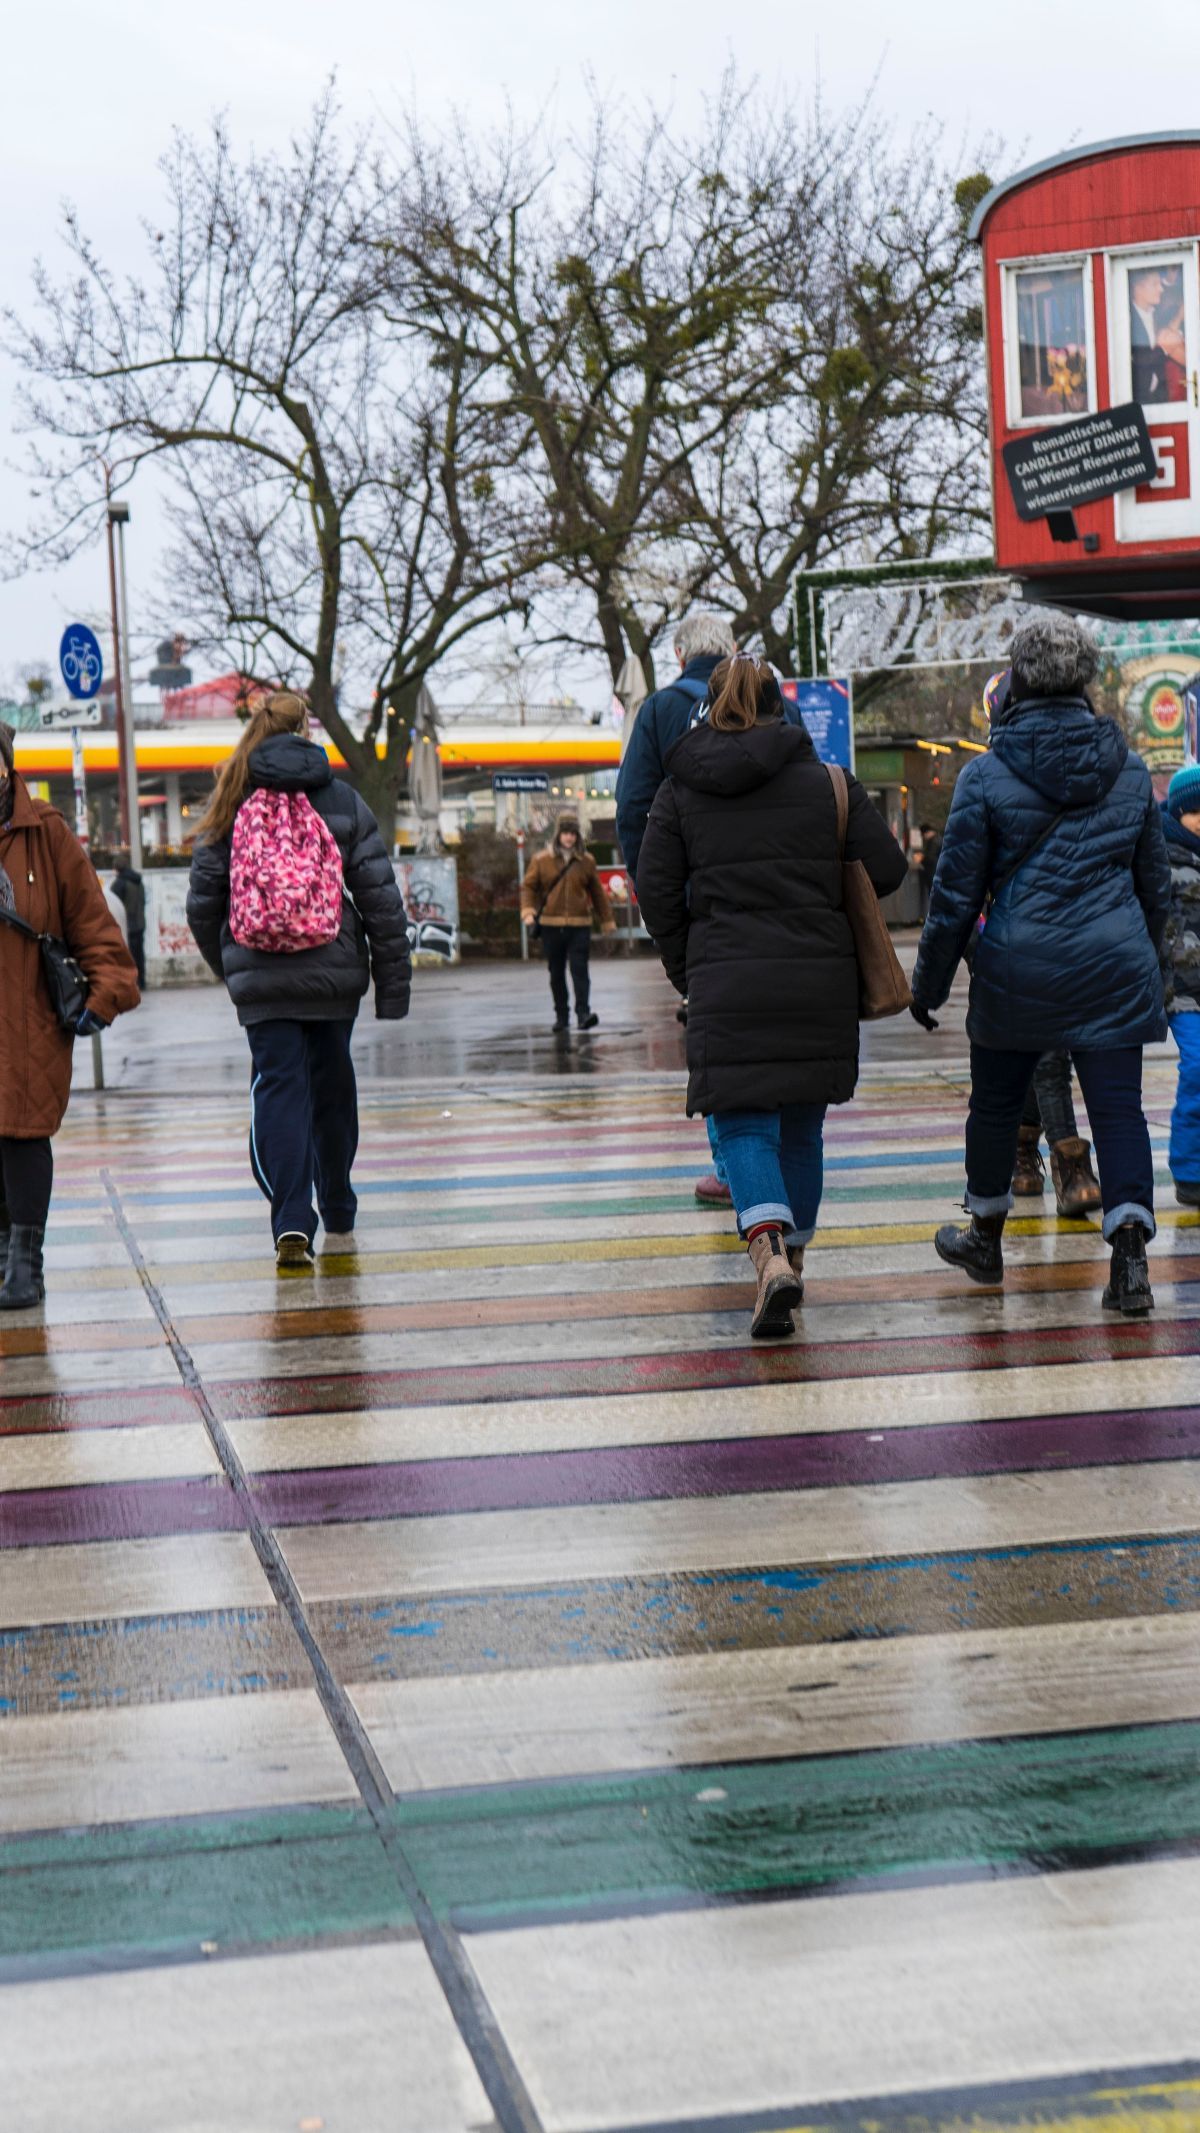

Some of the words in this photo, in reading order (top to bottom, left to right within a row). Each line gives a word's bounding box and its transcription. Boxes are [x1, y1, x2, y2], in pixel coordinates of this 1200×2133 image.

[1014, 442, 1092, 477] CANDLELIGHT
[1093, 425, 1140, 449] DINNER
[1032, 418, 1113, 454] Romantisches
[1025, 461, 1147, 511] wienerriesenrad.com
[1039, 463, 1081, 487] Wiener
[1083, 443, 1141, 471] Riesenrad
